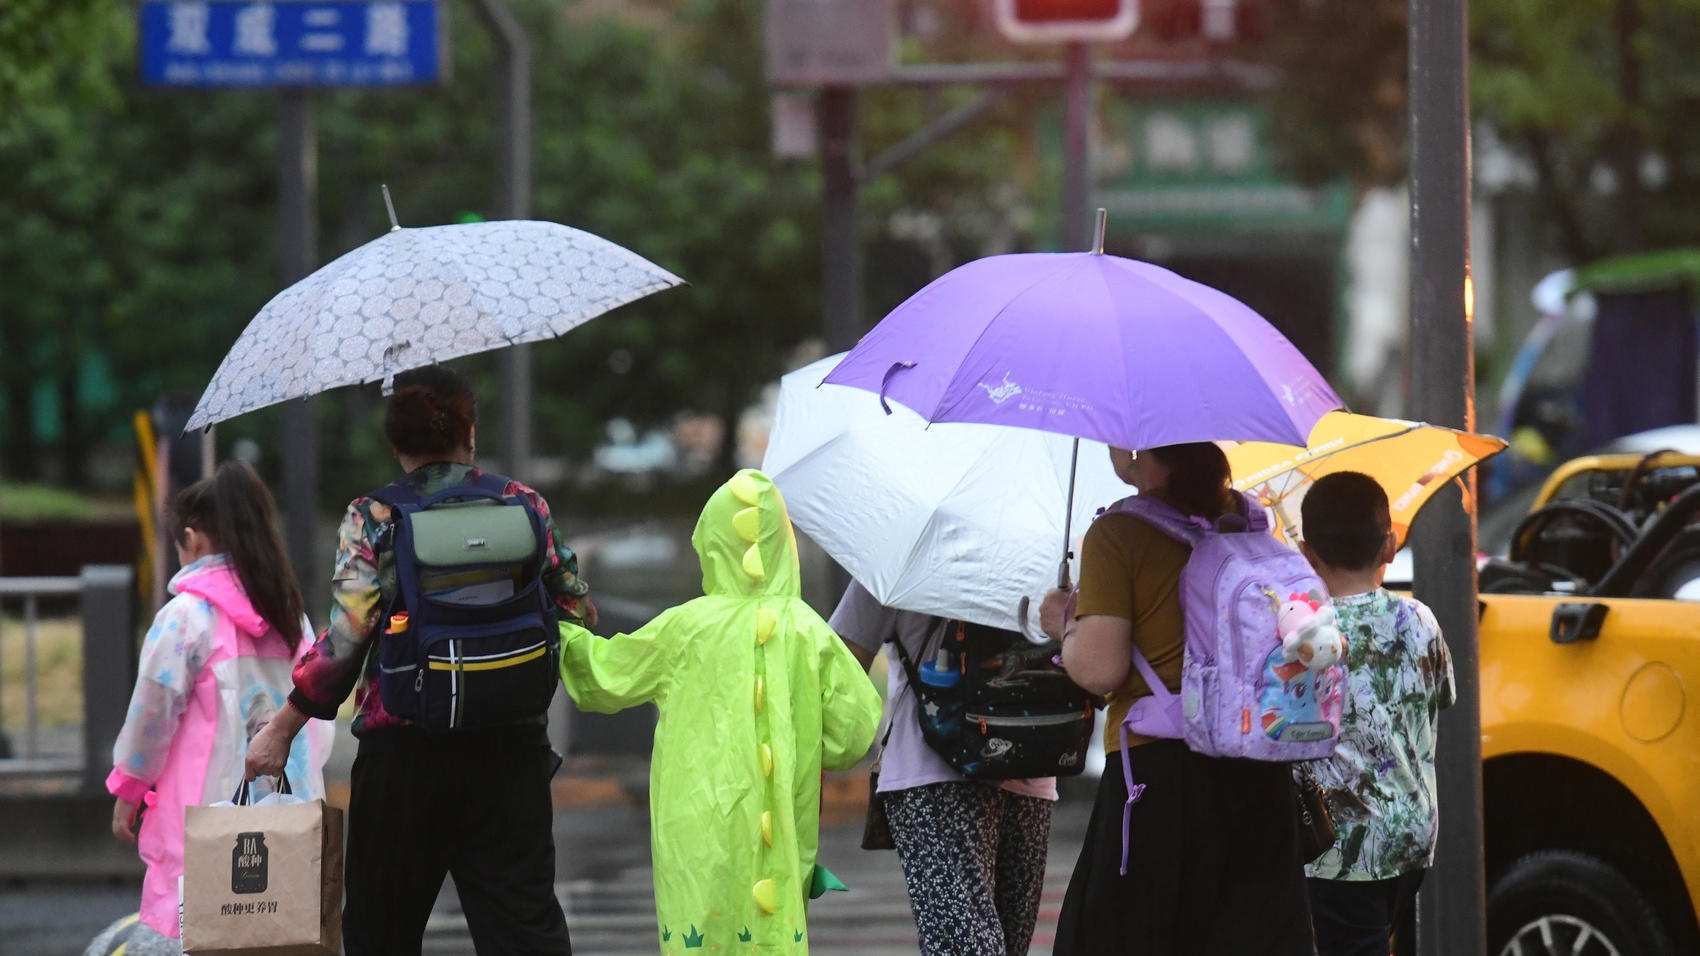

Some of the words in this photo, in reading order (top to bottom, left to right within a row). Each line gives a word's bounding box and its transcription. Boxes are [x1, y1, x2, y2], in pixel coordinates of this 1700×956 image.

[238, 854, 263, 868] 酸种
[220, 901, 278, 916] 酸种更养胃
